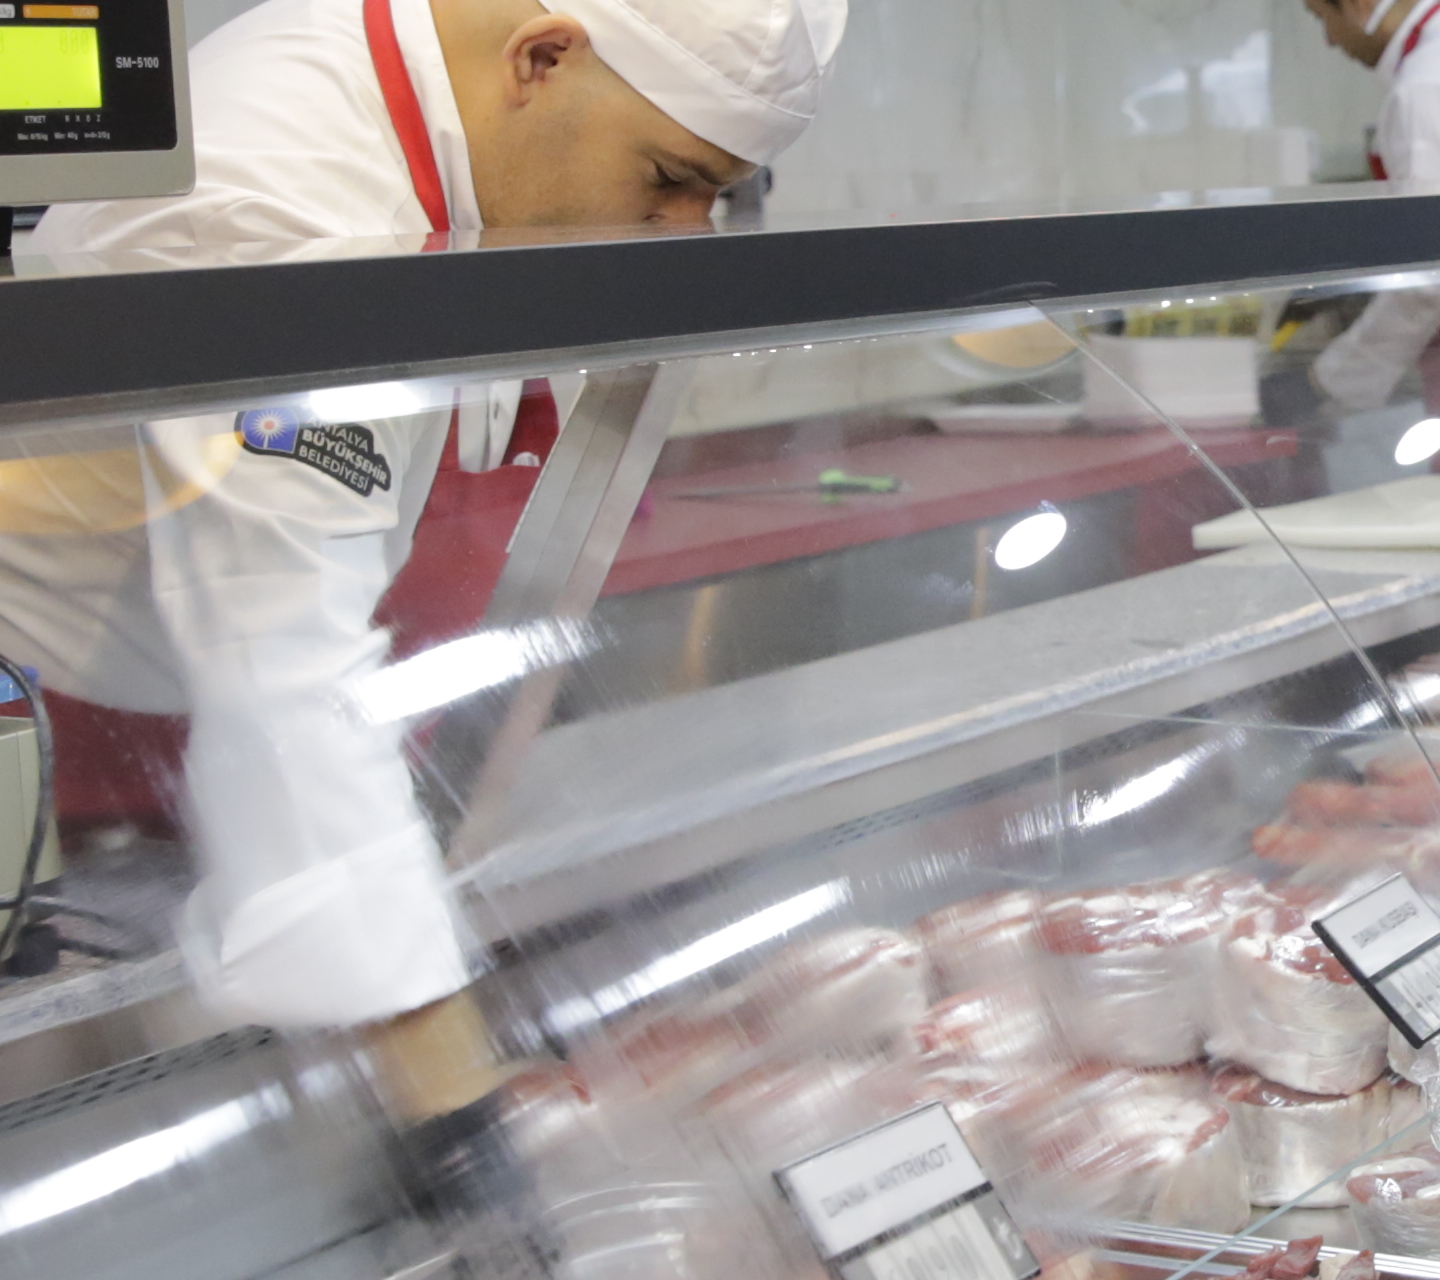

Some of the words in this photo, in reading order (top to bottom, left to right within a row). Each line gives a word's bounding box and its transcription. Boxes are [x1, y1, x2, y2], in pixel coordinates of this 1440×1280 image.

[116, 56, 159, 68] SM-5100
[307, 417, 368, 452] ANTALYA
[299, 445, 369, 491] BELEDİYESİ
[302, 429, 387, 484] BÜYÜKŞEHİR
